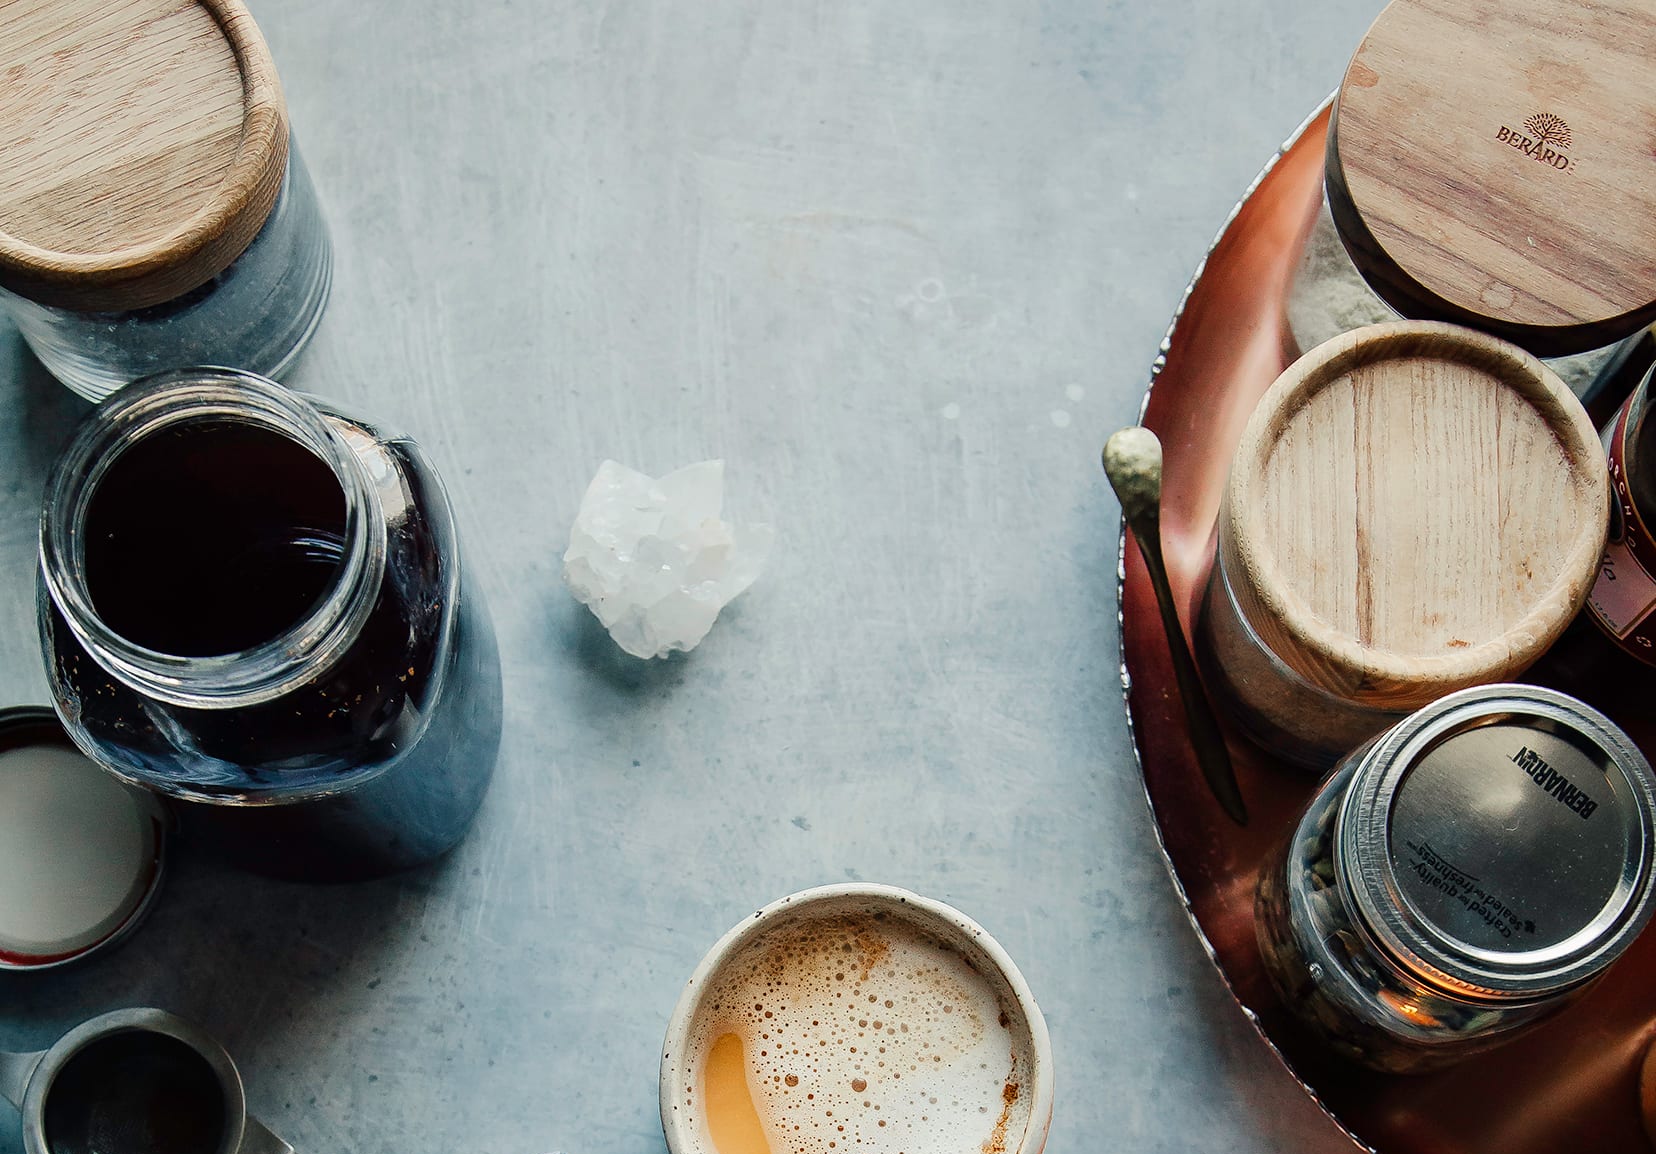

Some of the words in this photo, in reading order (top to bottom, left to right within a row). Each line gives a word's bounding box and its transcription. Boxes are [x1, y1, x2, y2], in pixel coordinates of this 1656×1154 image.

[1512, 746, 1598, 820] BERNARDIN
[1412, 862, 1458, 897] quality
[1419, 846, 1476, 895] freshness
